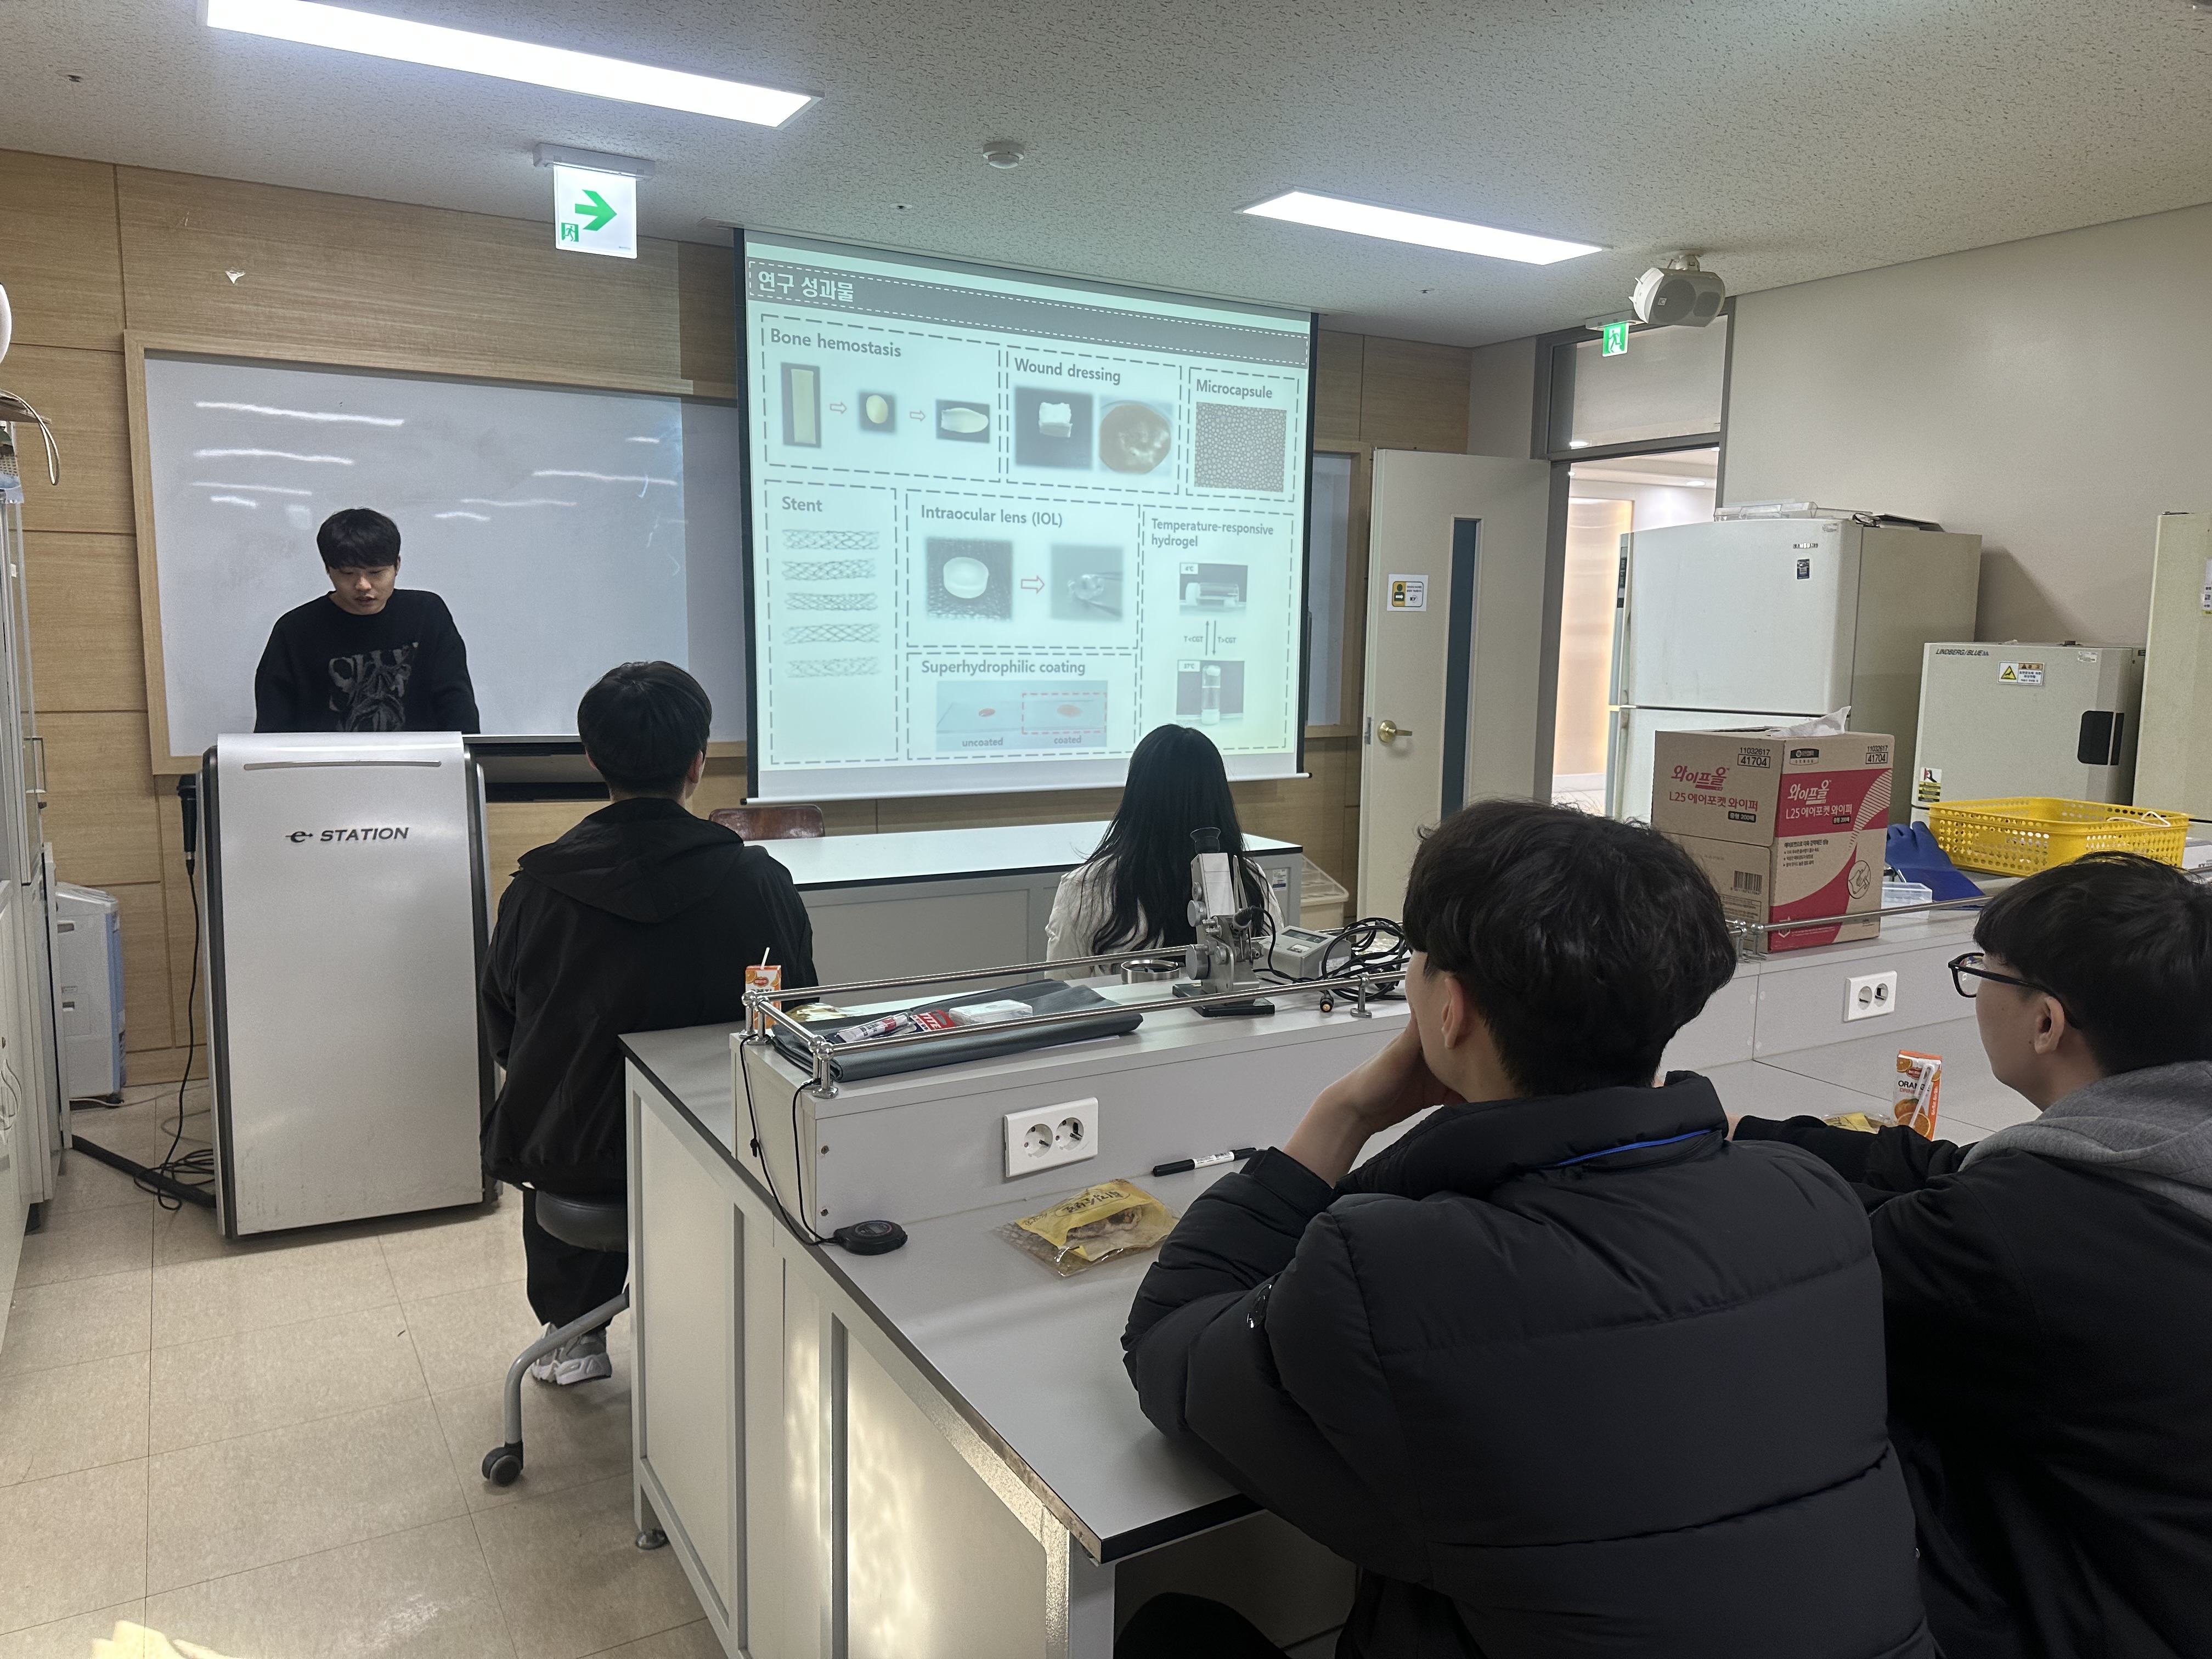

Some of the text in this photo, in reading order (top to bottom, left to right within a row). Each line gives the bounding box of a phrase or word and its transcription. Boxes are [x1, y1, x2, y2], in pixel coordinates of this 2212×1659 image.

[758, 271, 853, 302] 연구 성과물
[771, 328, 901, 357] Bone hemostasis
[1015, 358, 1121, 385] Wound dressing
[1196, 379, 1272, 399] Microcapsule
[782, 496, 822, 512] Stent
[921, 505, 1063, 528] Intraocular lens (IOL)
[1152, 518, 1274, 535] Temperature-responsive
[1152, 533, 1198, 549] hydrogel
[922, 659, 1085, 676] Superhydrophilic coating
[962, 737, 1003, 747] uncoated
[1054, 735, 1081, 744] coated
[1740, 747, 1770, 755] 11032617
[1867, 753, 1886, 763] 41704
[1741, 756, 1767, 766] 41704
[1669, 791, 1758, 811] L25 에어포켓 와이퍼
[1786, 804, 1852, 819] L25 에어포켓 와이퍼
[320, 827, 409, 841] STATION
